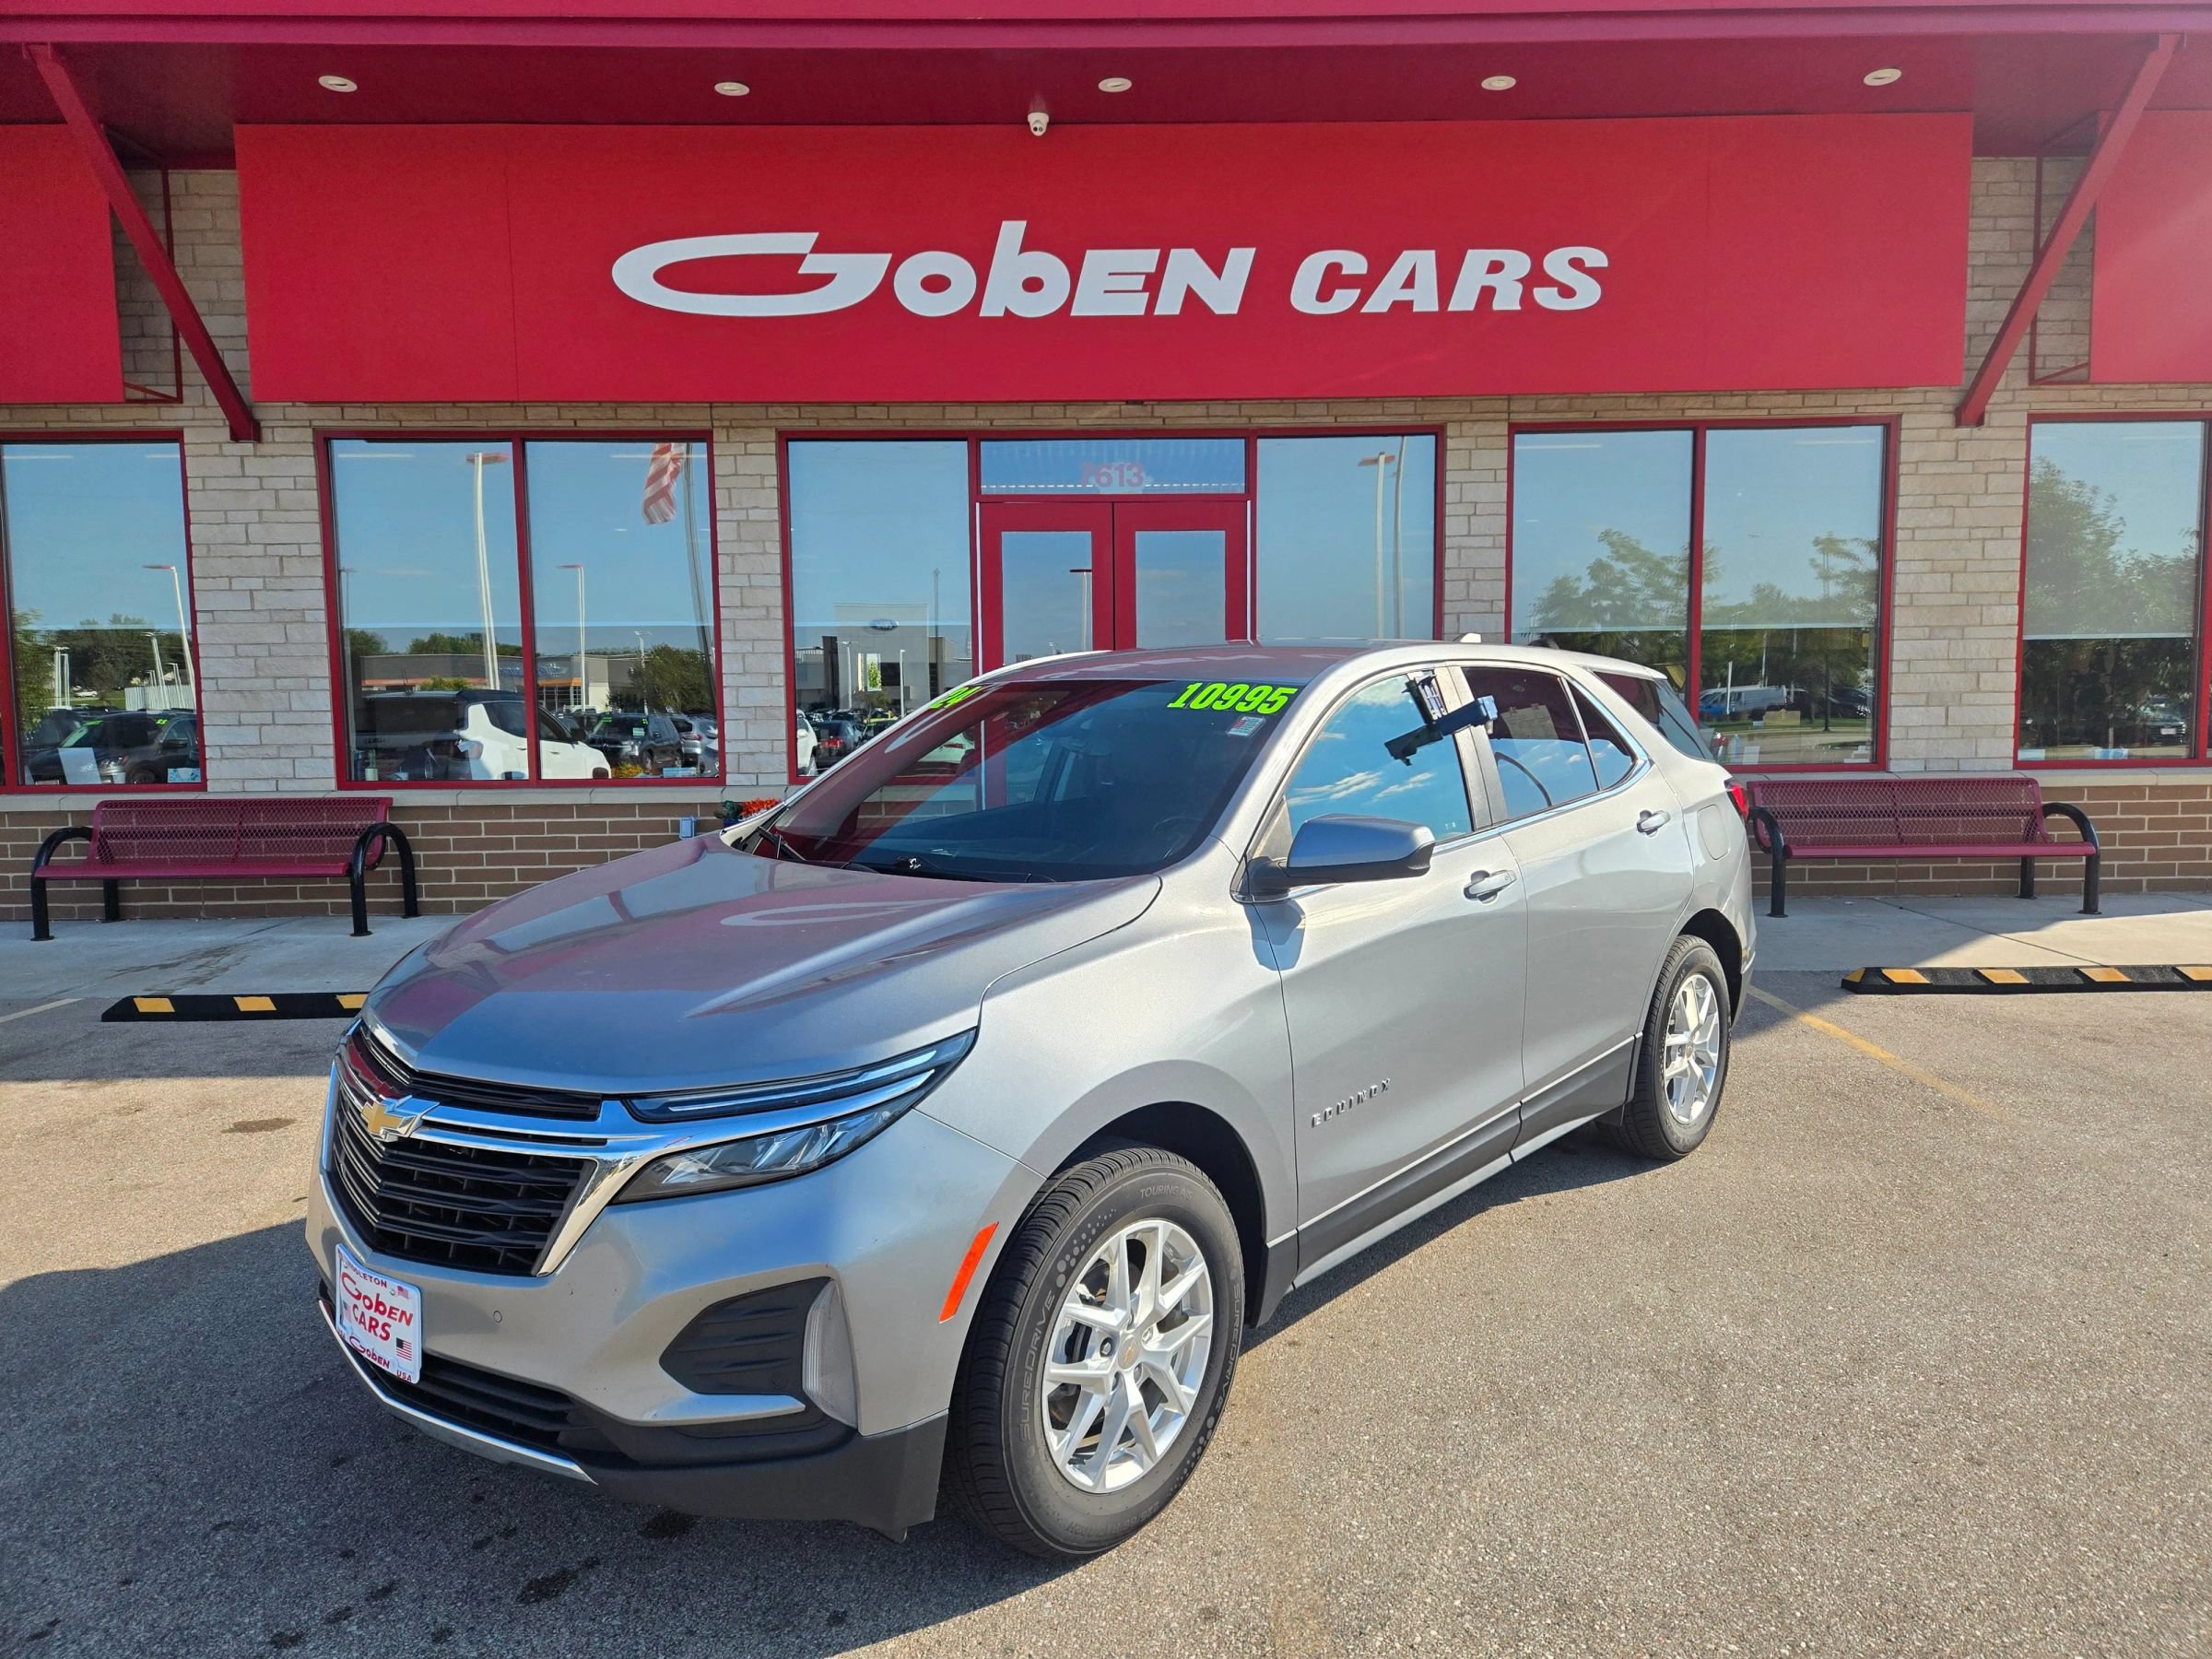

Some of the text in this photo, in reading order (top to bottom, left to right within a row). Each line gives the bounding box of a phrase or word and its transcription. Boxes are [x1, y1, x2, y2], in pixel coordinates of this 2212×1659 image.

[1289, 246, 1609, 314] CARS
[1079, 462, 1145, 488] 7613
[1167, 682, 1299, 715] 10995
[1312, 1077, 1391, 1128] EQUINOX
[1140, 1184, 1180, 1199] TOURING
[352, 1303, 392, 1342] CARS
[1018, 1289, 1056, 1442] SUREDRIVE
[1216, 1283, 1241, 1414] SUREDRIVE
[396, 1370, 412, 1382] USA
